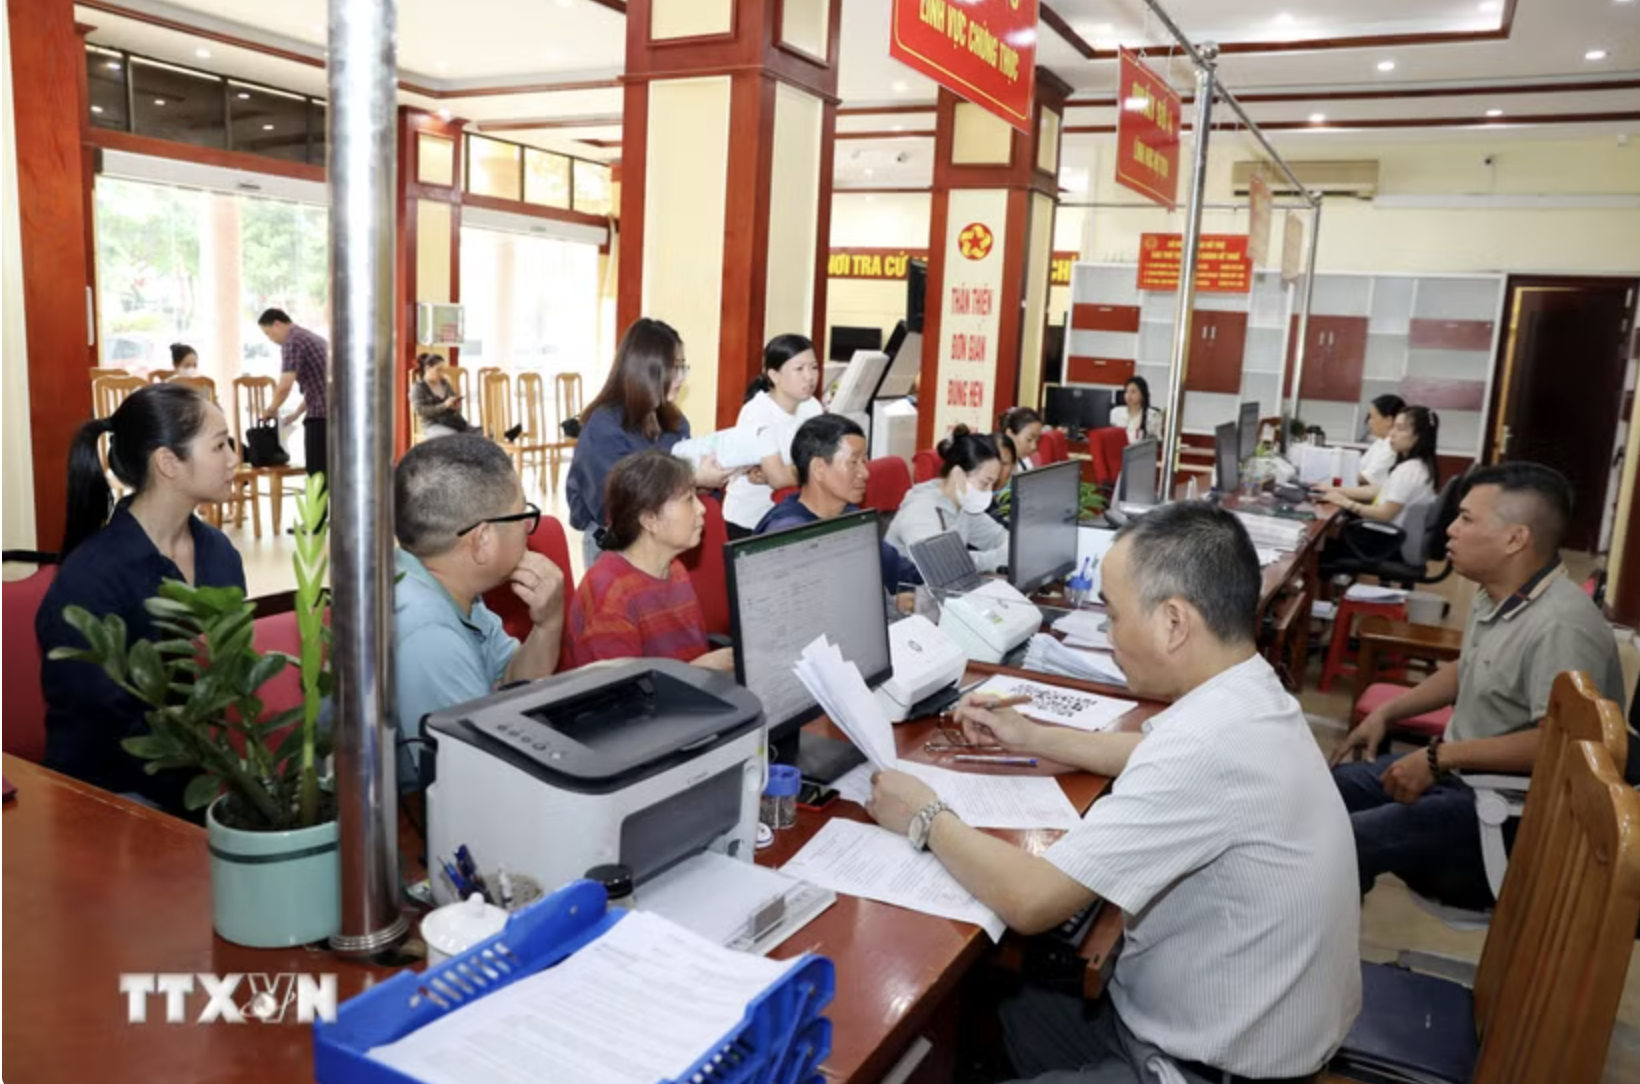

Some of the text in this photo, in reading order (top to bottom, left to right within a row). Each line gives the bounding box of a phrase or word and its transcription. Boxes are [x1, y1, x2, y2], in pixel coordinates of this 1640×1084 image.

[948, 4, 966, 50] VỰC
[852, 254, 882, 276] TRA
[884, 250, 913, 277] CỨ
